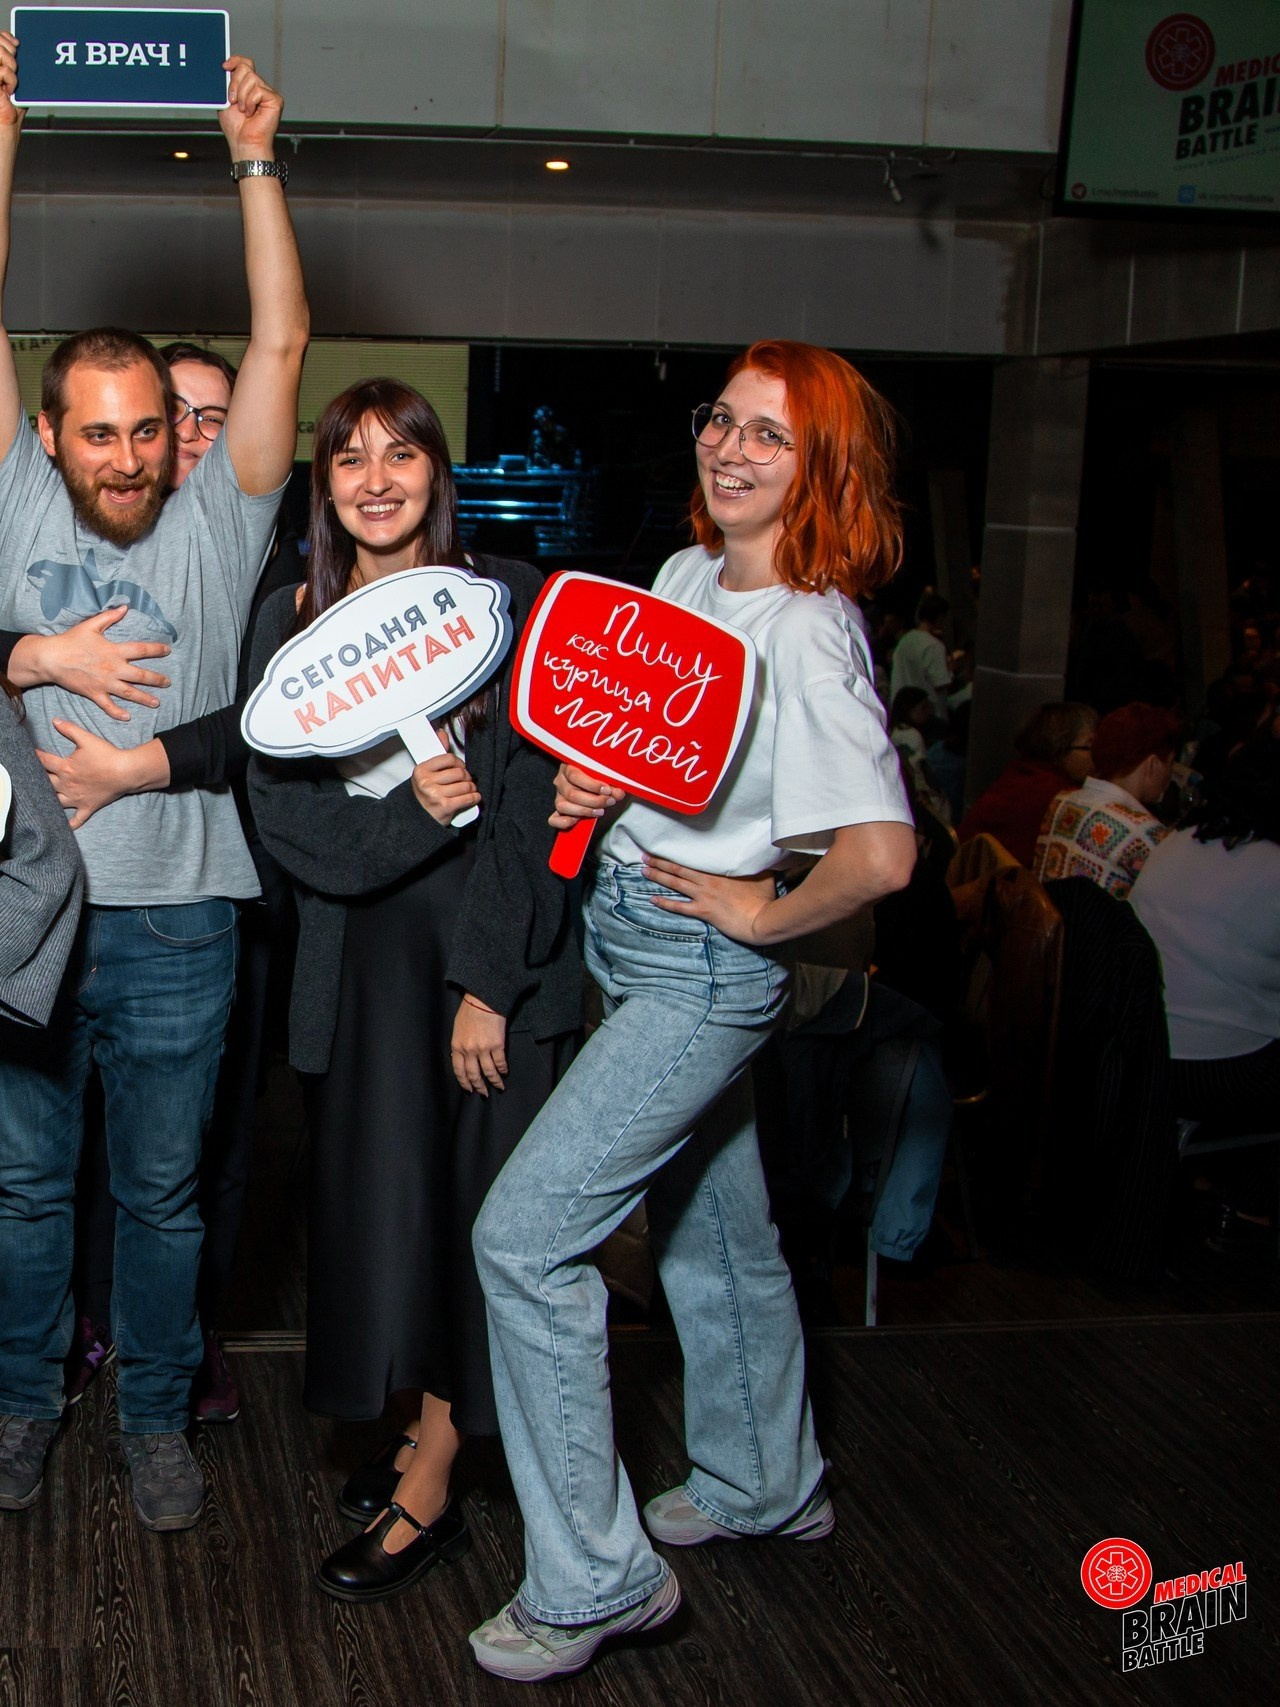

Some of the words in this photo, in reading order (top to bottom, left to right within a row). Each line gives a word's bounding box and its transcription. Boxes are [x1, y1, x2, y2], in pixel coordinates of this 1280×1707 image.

[55, 42, 77, 65] Я
[1178, 75, 1280, 136] BRAI
[1175, 122, 1259, 160] BATTLE
[280, 604, 428, 700] СЕГОДНЯ
[433, 587, 457, 615] Я
[566, 633, 609, 660] как
[603, 601, 722, 727] Пишу
[293, 615, 475, 735] КАПИТАН
[543, 651, 651, 712] курица
[554, 697, 708, 783] лапой
